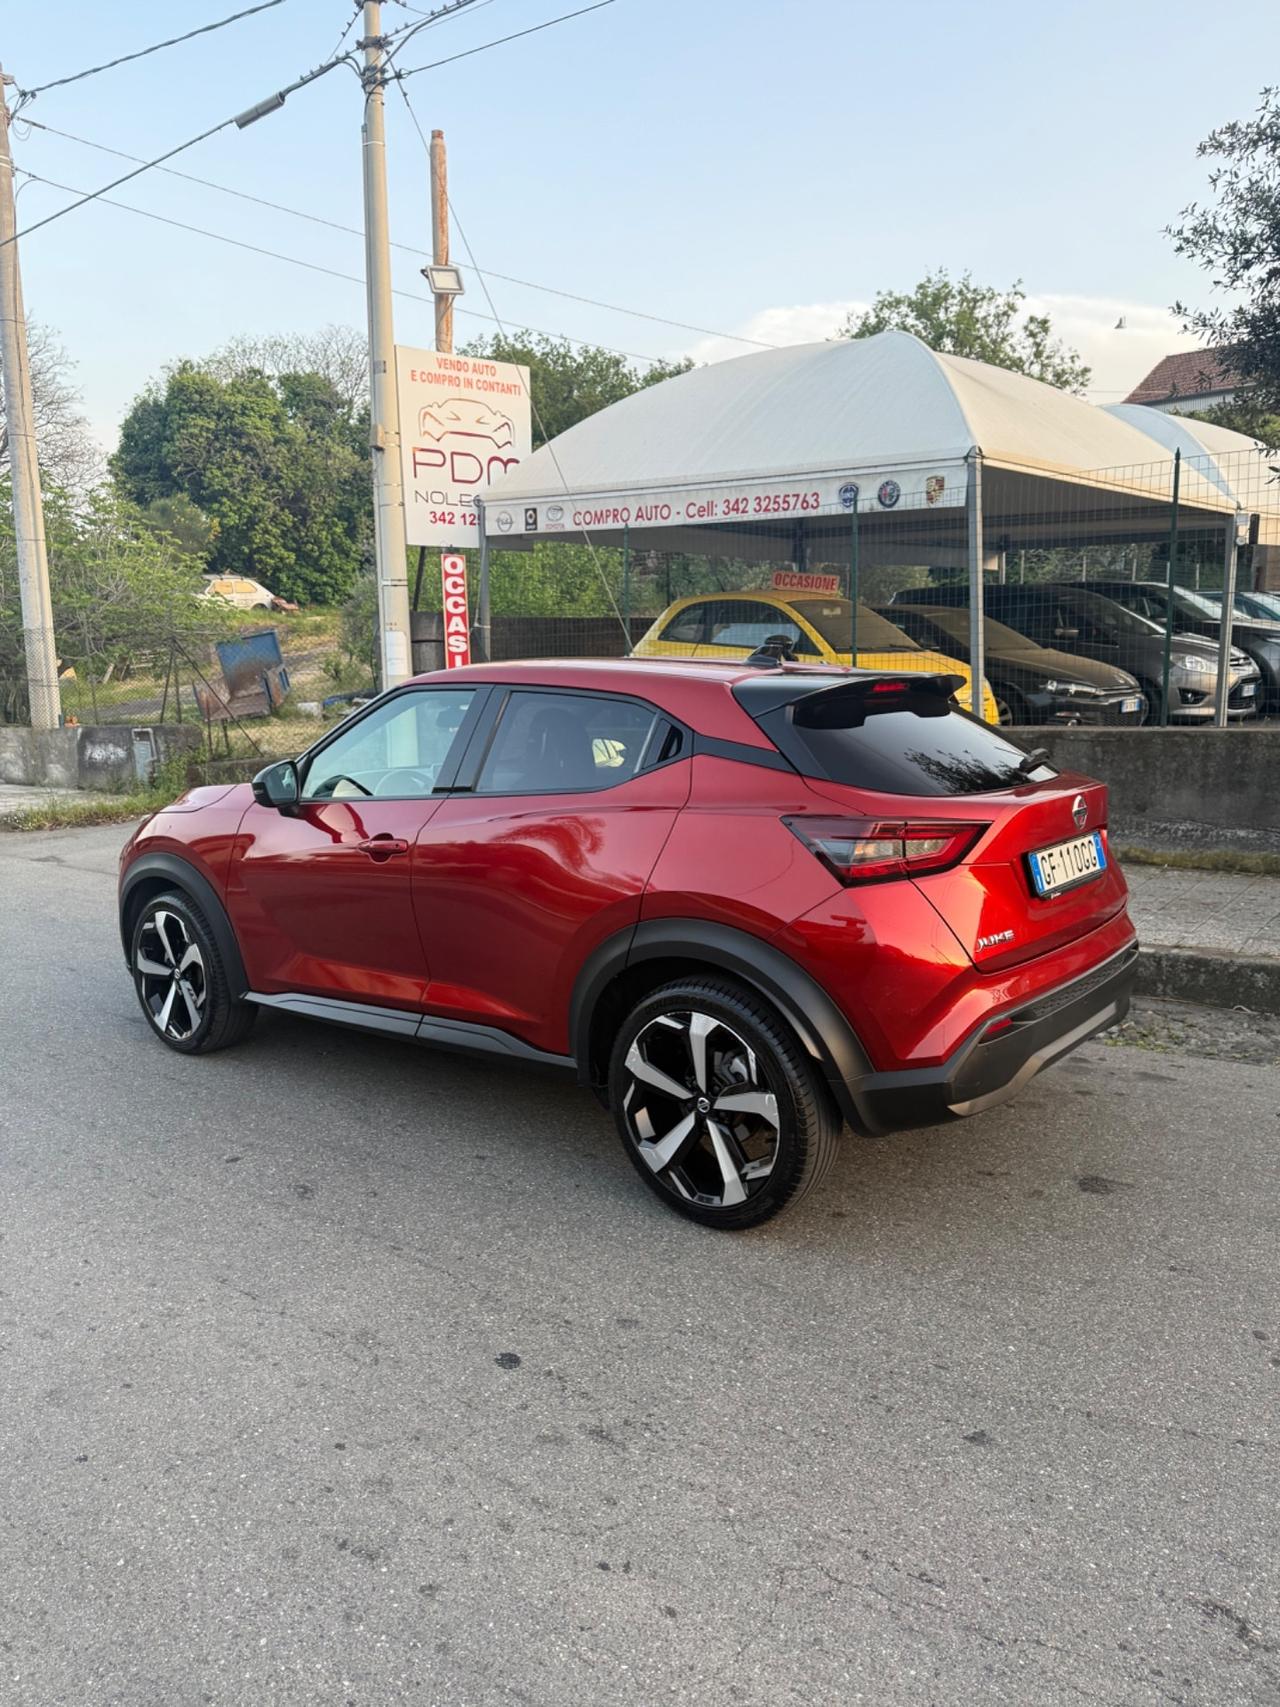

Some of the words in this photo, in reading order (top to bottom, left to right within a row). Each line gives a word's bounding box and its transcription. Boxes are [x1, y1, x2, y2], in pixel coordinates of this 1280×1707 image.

[436, 357, 469, 373] VENDO
[472, 363, 497, 377] AUTO
[410, 369, 417, 382] E
[420, 371, 460, 388] COMPRO
[463, 377, 473, 390] IN
[476, 380, 521, 396] CONTANTI
[429, 511, 456, 525] 342
[573, 506, 631, 526] COMPRO
[635, 503, 671, 522] AUTO
[685, 501, 718, 519] Cell:
[722, 497, 749, 516] 342
[753, 491, 820, 514] 3255763
[774, 573, 838, 592] OCCASIONE
[975, 929, 1015, 953] JUKE
